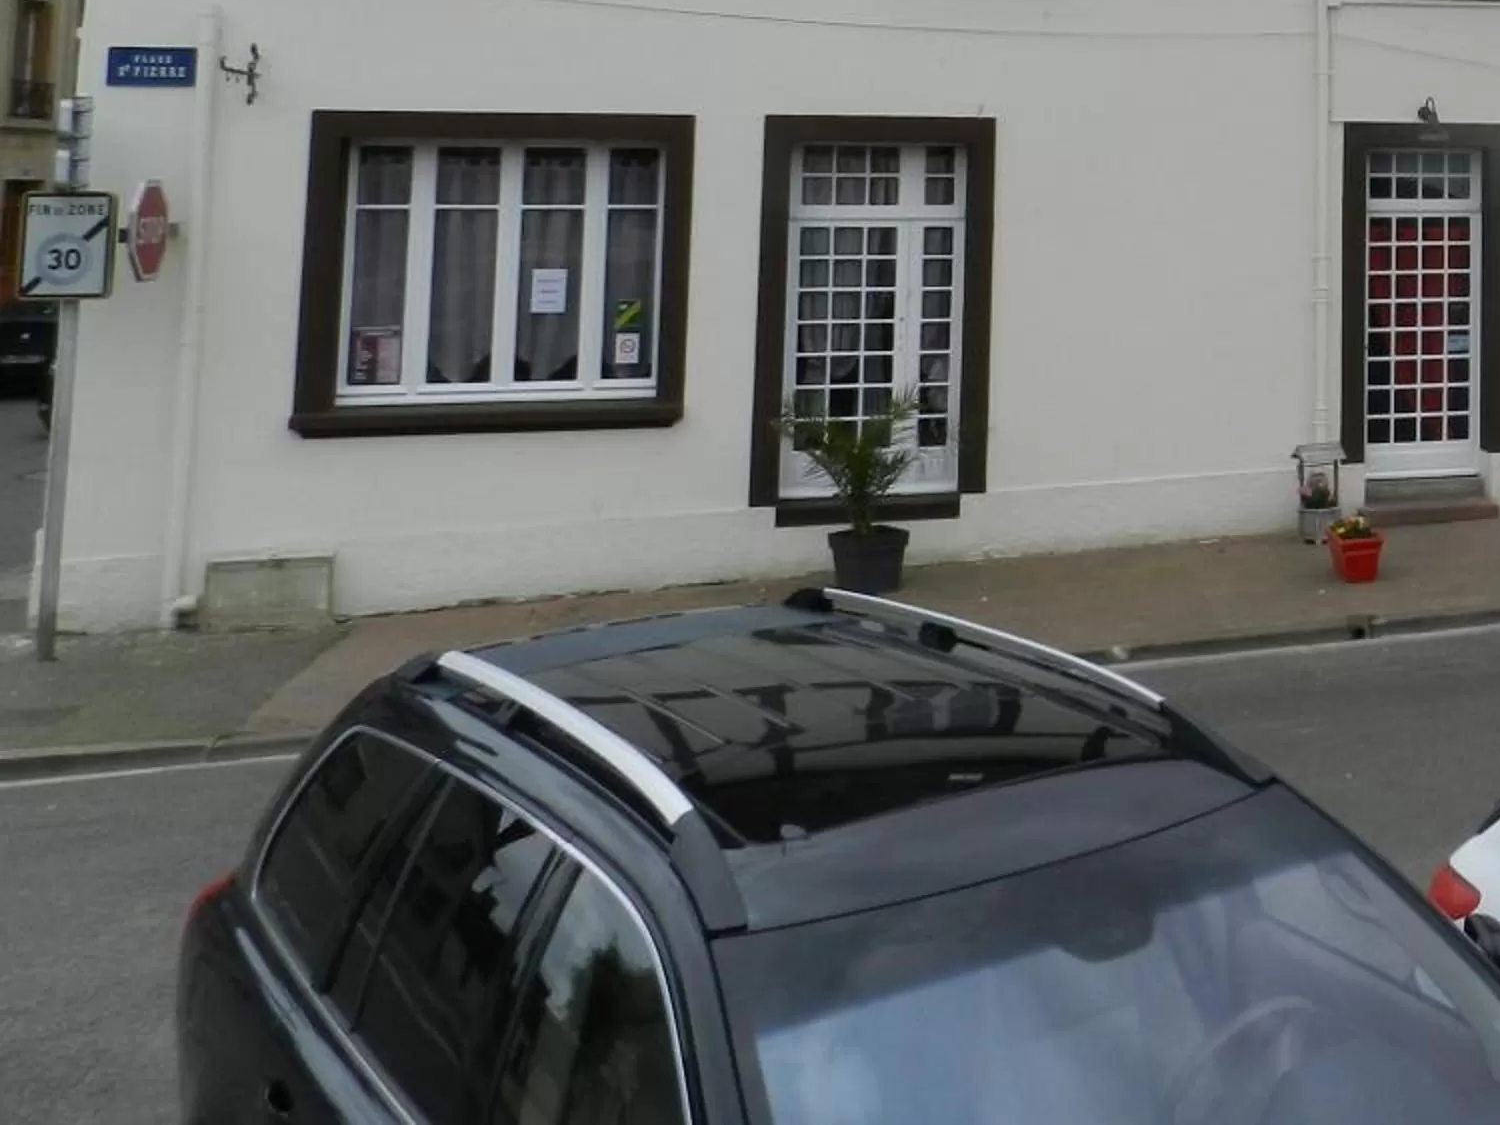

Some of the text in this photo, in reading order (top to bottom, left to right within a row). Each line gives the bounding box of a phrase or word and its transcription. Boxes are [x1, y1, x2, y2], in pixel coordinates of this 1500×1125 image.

[133, 66, 187, 78] PIERRE
[29, 204, 51, 216] FIN
[67, 204, 105, 216] ZONE
[48, 248, 81, 270] 30
